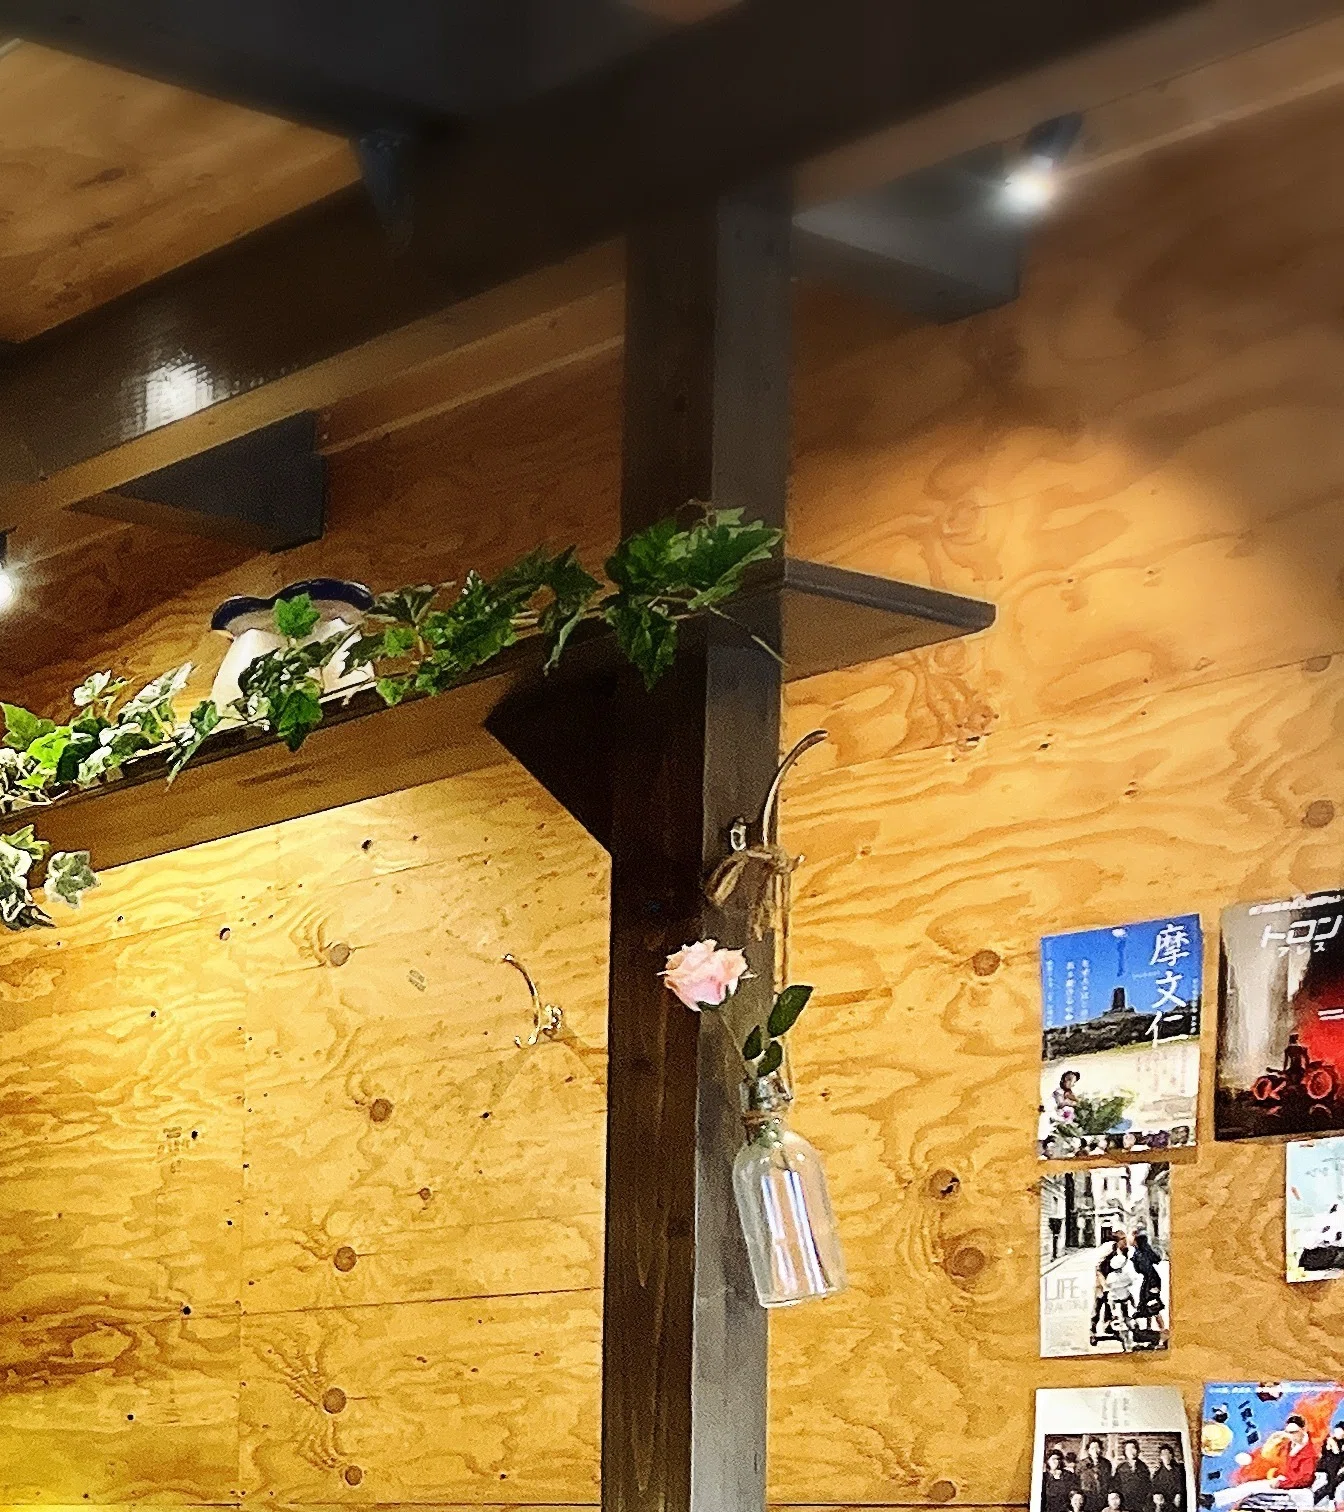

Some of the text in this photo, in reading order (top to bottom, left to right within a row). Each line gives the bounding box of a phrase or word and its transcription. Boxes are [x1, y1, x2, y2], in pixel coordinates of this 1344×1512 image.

[1261, 914, 1343, 948] トロン
[1145, 923, 1190, 1048] 摩文仁
[1044, 1276, 1080, 1302] LIFE
